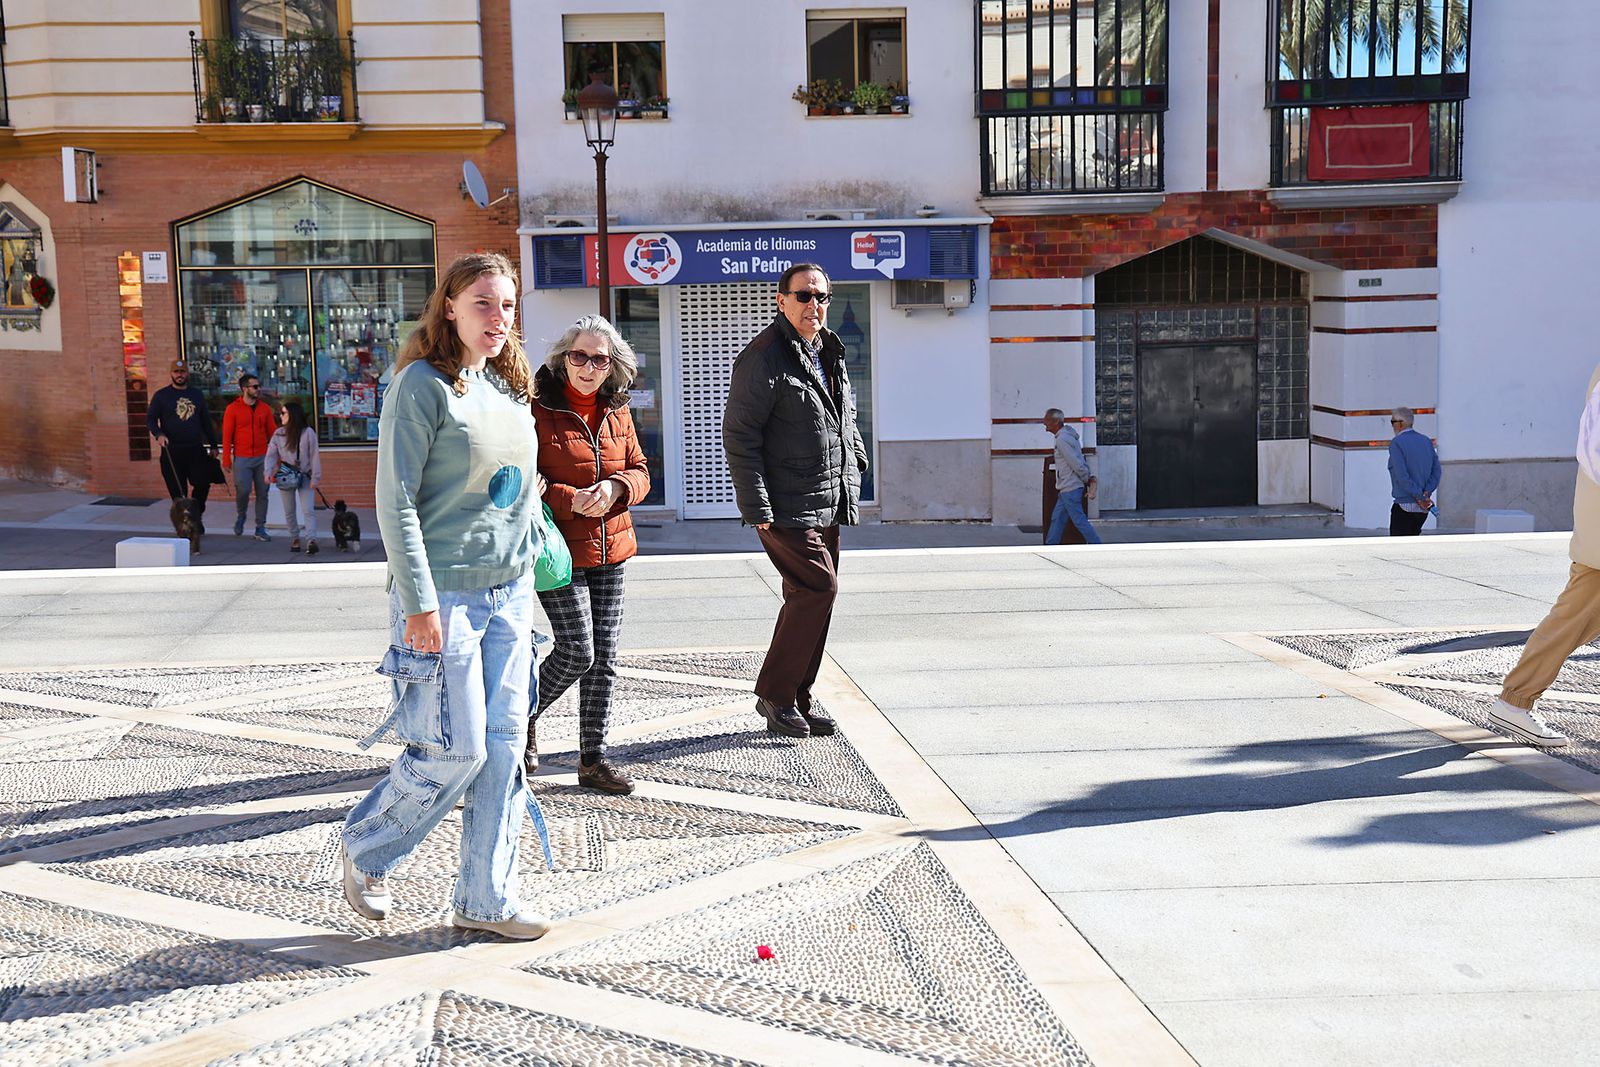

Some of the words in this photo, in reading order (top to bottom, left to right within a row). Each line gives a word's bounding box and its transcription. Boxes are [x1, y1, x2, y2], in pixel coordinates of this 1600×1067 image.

[696, 238, 751, 252] Academia
[754, 237, 769, 251] de
[771, 237, 817, 250] Idiomas
[891, 249, 900, 257] Tag
[721, 257, 748, 274] San
[751, 256, 793, 273] Pedro
